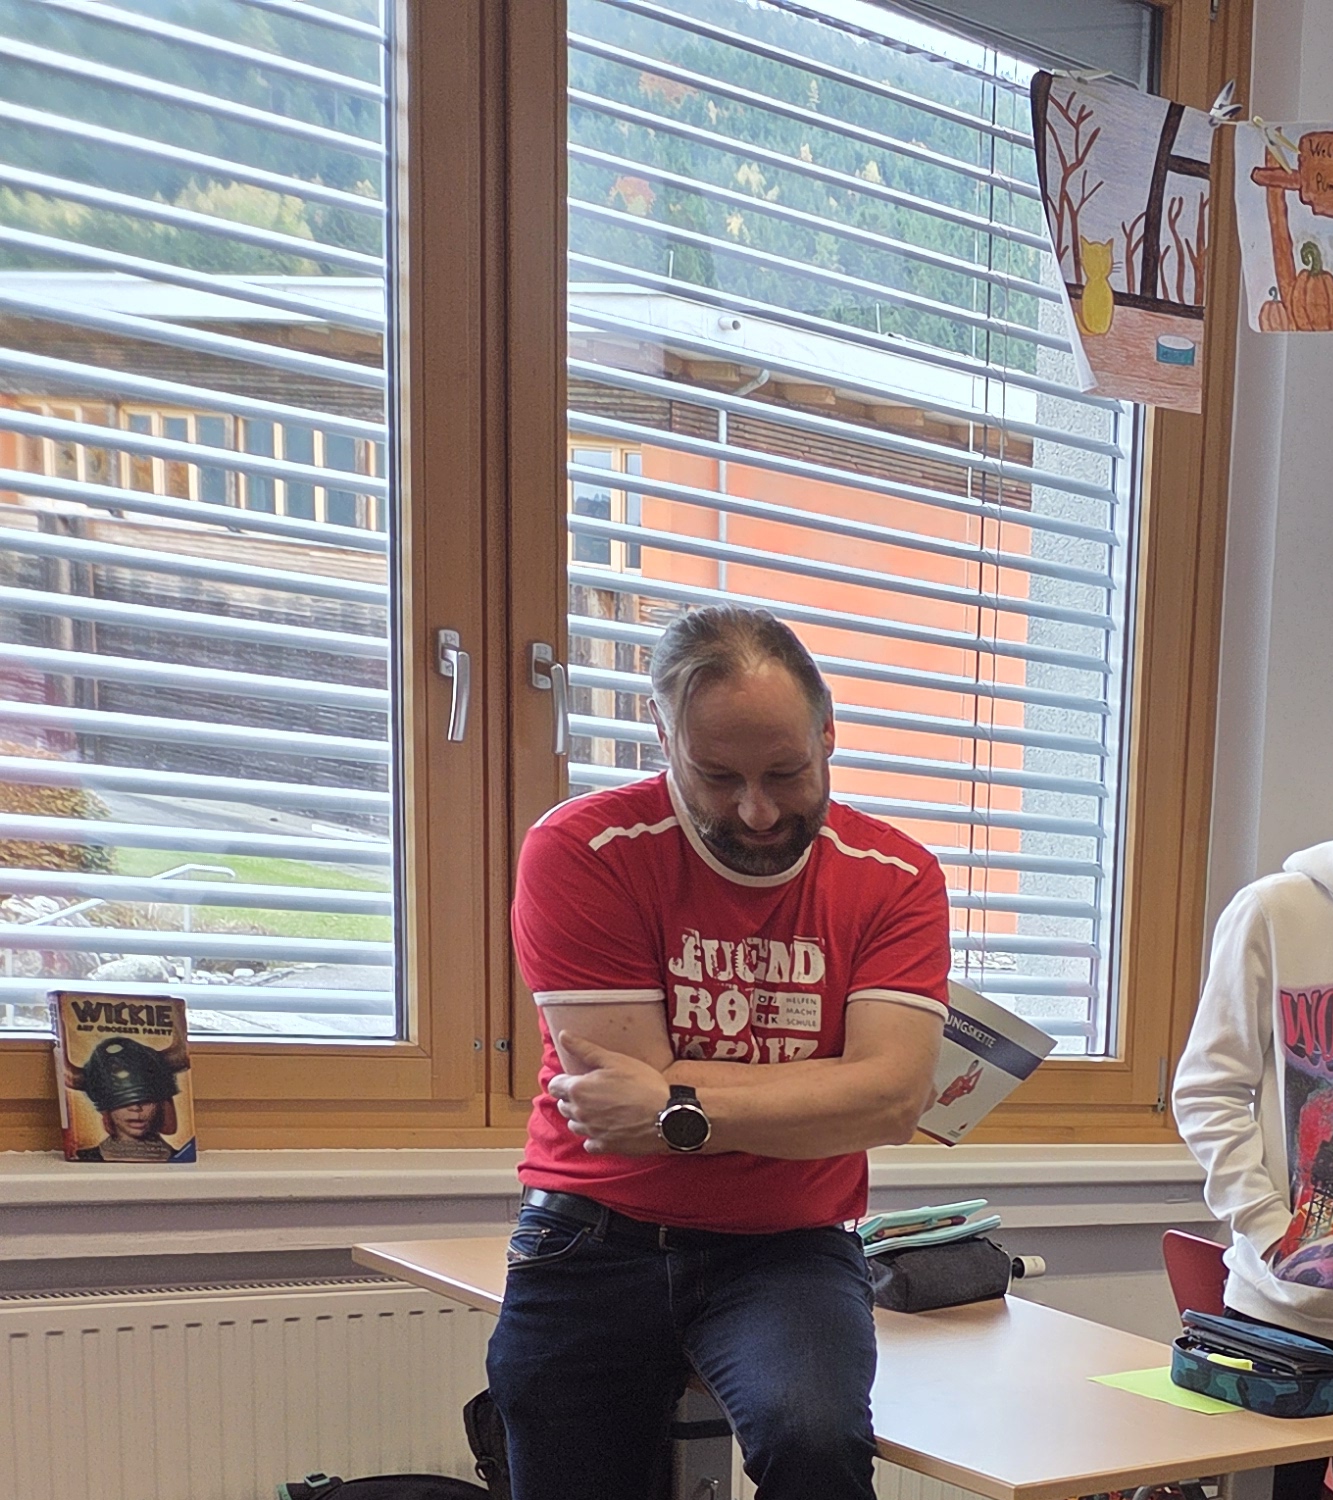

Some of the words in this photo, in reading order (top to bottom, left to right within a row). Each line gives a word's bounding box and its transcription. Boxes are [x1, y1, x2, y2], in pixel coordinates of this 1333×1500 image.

[672, 984, 754, 1036] RO
[786, 997, 817, 1005] HELFEN
[71, 1000, 173, 1028] WICKIE
[786, 1007, 817, 1016] MACHT
[786, 1018, 817, 1027] SCHULE
[947, 1014, 997, 1049] UNGSKETTE
